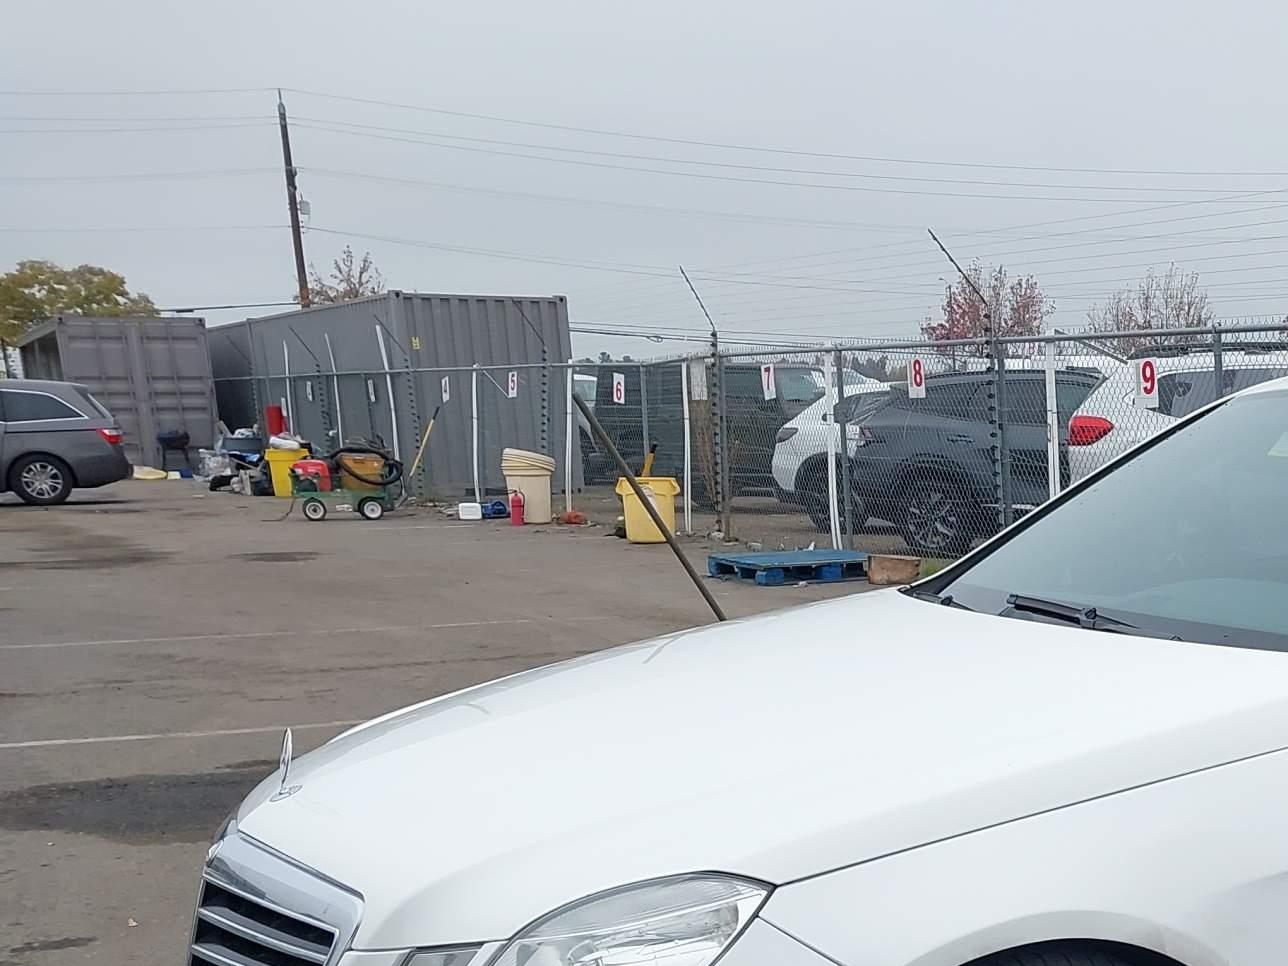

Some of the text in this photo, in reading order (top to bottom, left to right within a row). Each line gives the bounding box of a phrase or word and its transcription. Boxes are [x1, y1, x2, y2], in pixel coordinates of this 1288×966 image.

[764, 366, 771, 390] 7
[913, 359, 923, 387] 8
[1141, 360, 1156, 395] 9
[615, 381, 622, 400] 6
